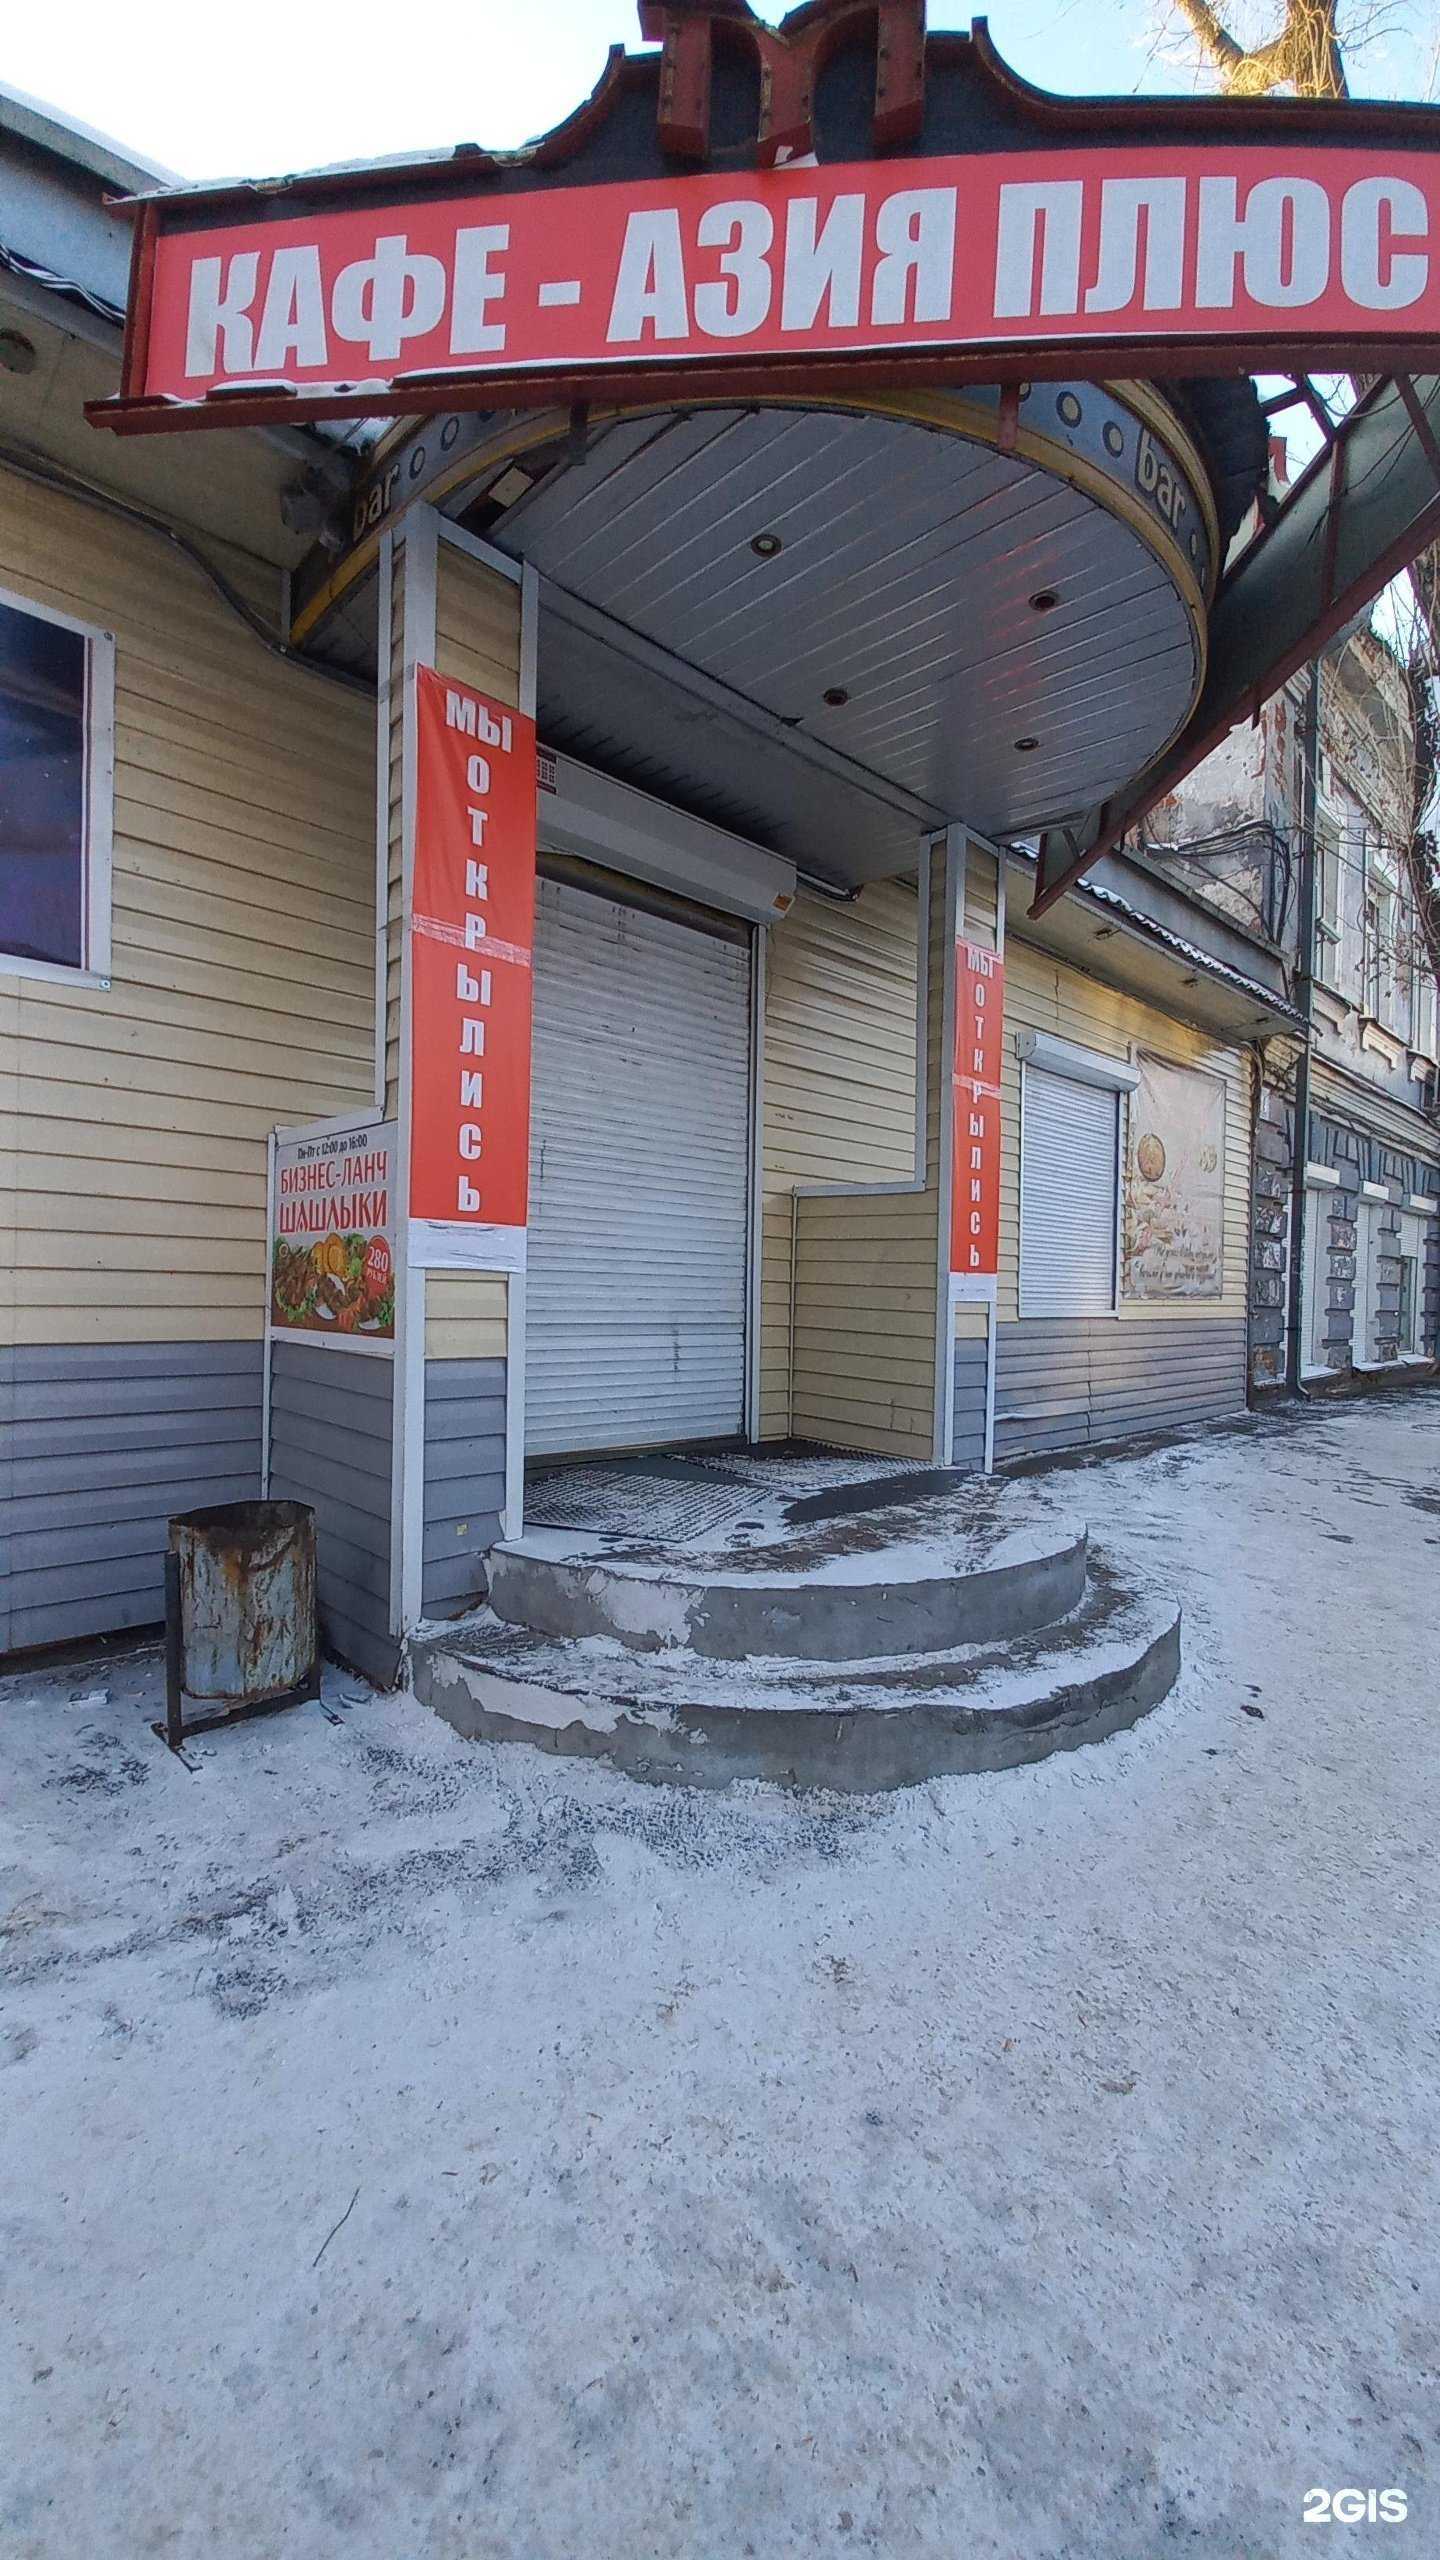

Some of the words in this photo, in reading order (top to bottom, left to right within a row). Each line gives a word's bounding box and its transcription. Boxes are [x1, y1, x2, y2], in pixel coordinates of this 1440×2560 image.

[184, 223, 511, 378] КАФЕ
[605, 186, 958, 343] АЗИЯ
[992, 175, 1430, 319] ПЛЮС
[1135, 425, 1187, 532] bar
[445, 688, 513, 754] МЫ
[455, 754, 492, 1214] ОТКРЫЛИСЬ
[967, 946, 995, 979] МЫ
[297, 1146, 315, 1159] Пн-Пт
[322, 1141, 338, 1155] 12:00
[339, 1141, 348, 1154] до
[348, 1133, 368, 1150] 16:00
[968, 983, 986, 1268] ОТКРЫЛИСЬ
[281, 1151, 387, 1194] БИЗНЕС-ЛАНЧ
[280, 1190, 387, 1233] ШАШЛЫКИ
[367, 1246, 388, 1272] 280
